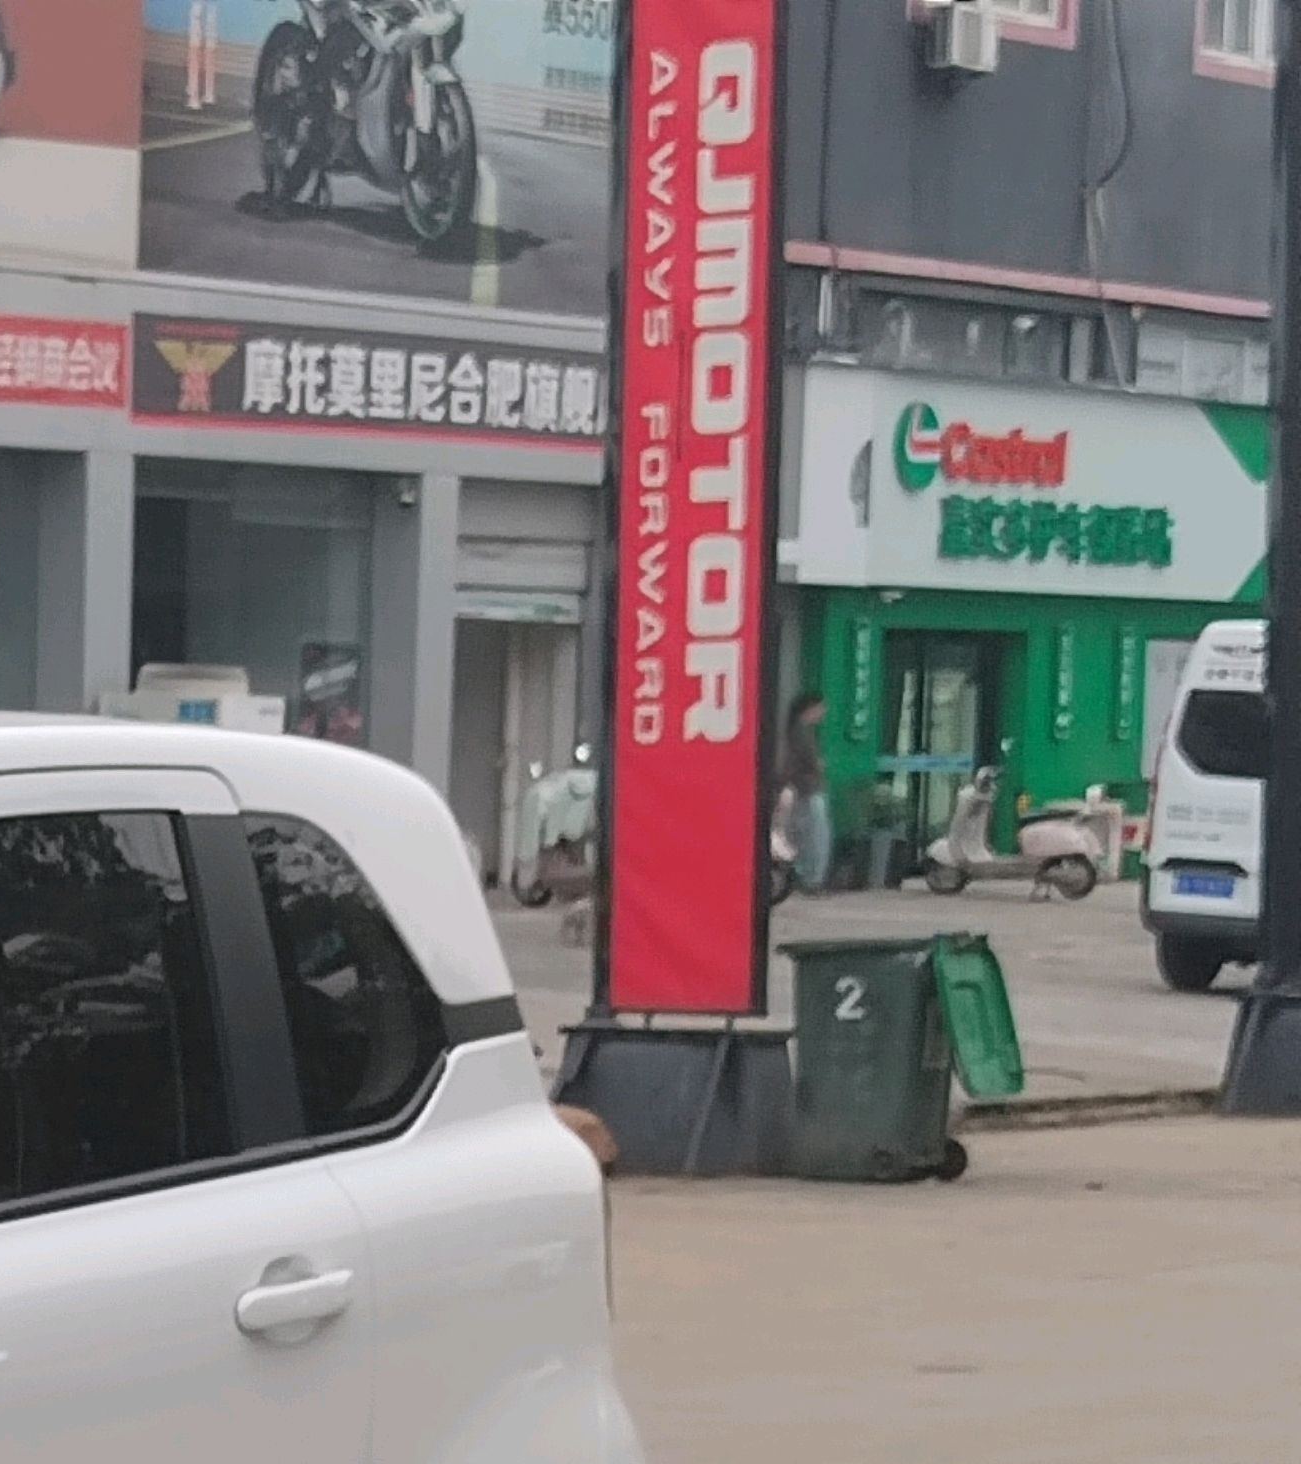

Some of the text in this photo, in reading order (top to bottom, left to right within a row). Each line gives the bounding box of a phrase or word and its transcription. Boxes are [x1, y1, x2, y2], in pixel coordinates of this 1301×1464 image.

[633, 50, 680, 744] ALWAYS FORWARD
[683, 39, 758, 743] QJMOTOR
[834, 975, 867, 1021] 2
